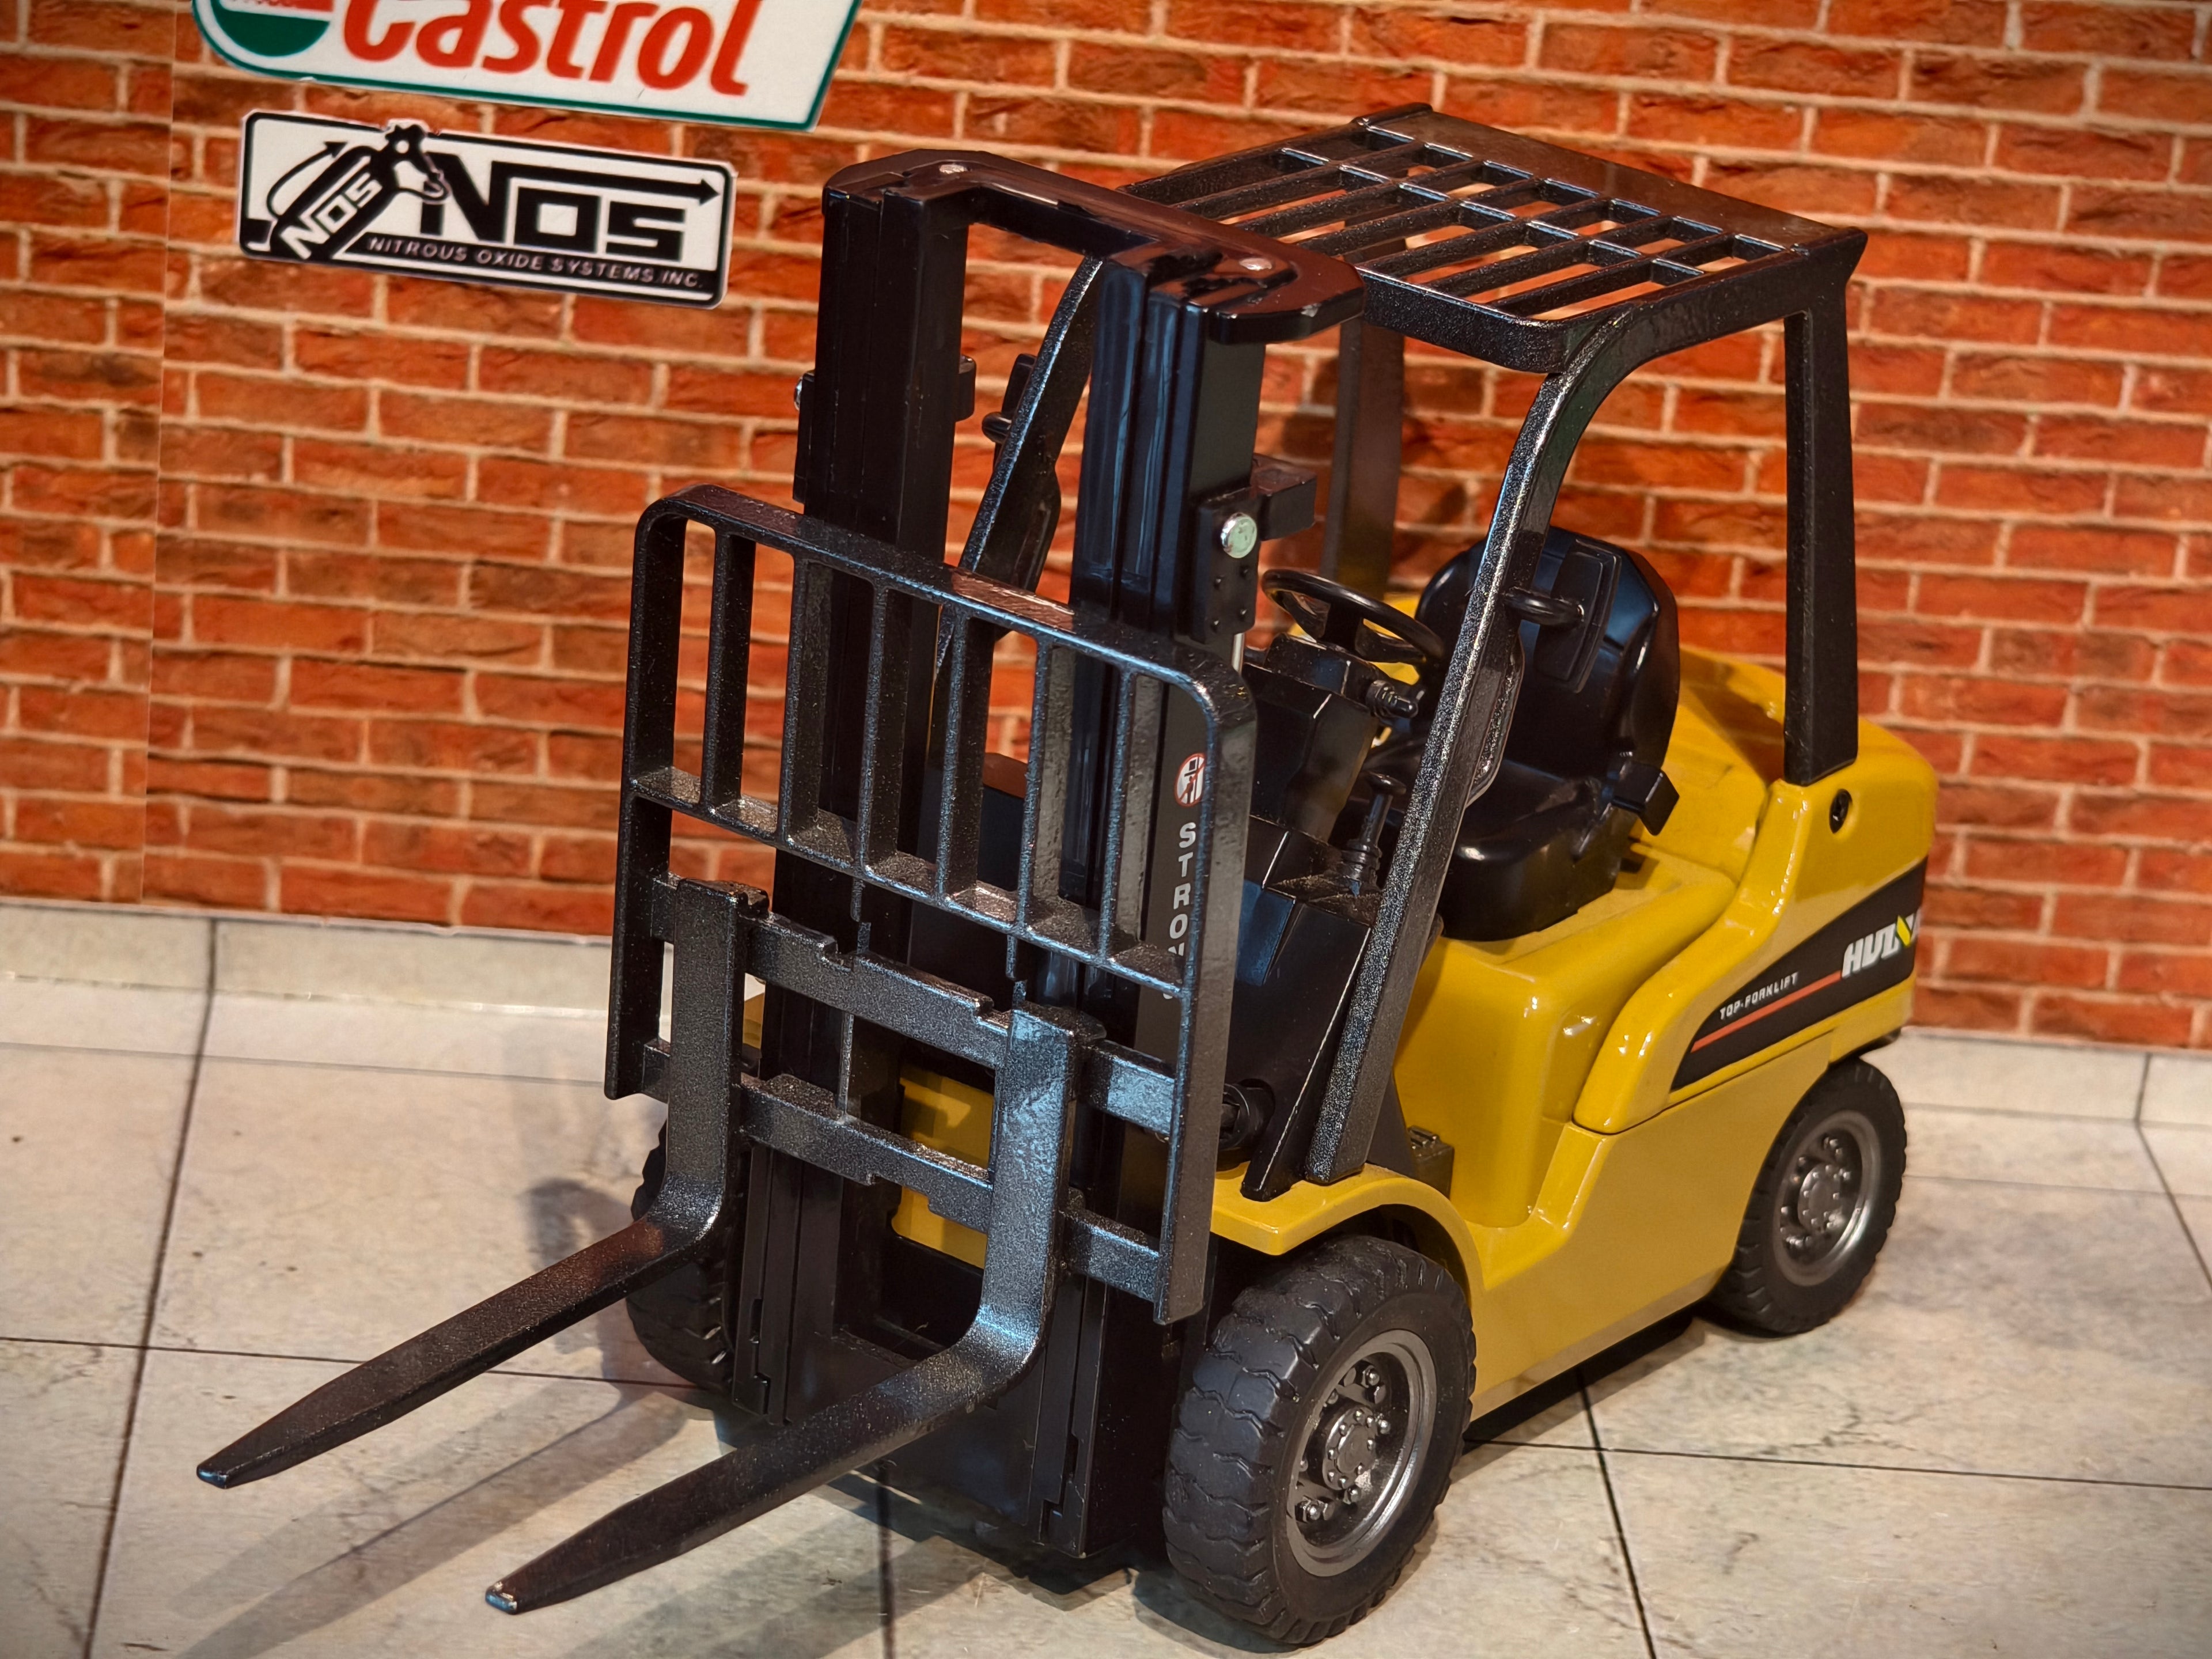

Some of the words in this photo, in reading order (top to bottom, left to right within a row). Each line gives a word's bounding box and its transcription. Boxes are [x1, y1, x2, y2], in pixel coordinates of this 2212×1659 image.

[344, 0, 763, 96] Castrol
[281, 173, 382, 260] NOS
[420, 151, 685, 262] NOS
[369, 237, 468, 262] NITROUS
[476, 249, 545, 270] OXIDE
[549, 258, 656, 283] SYSTEMS
